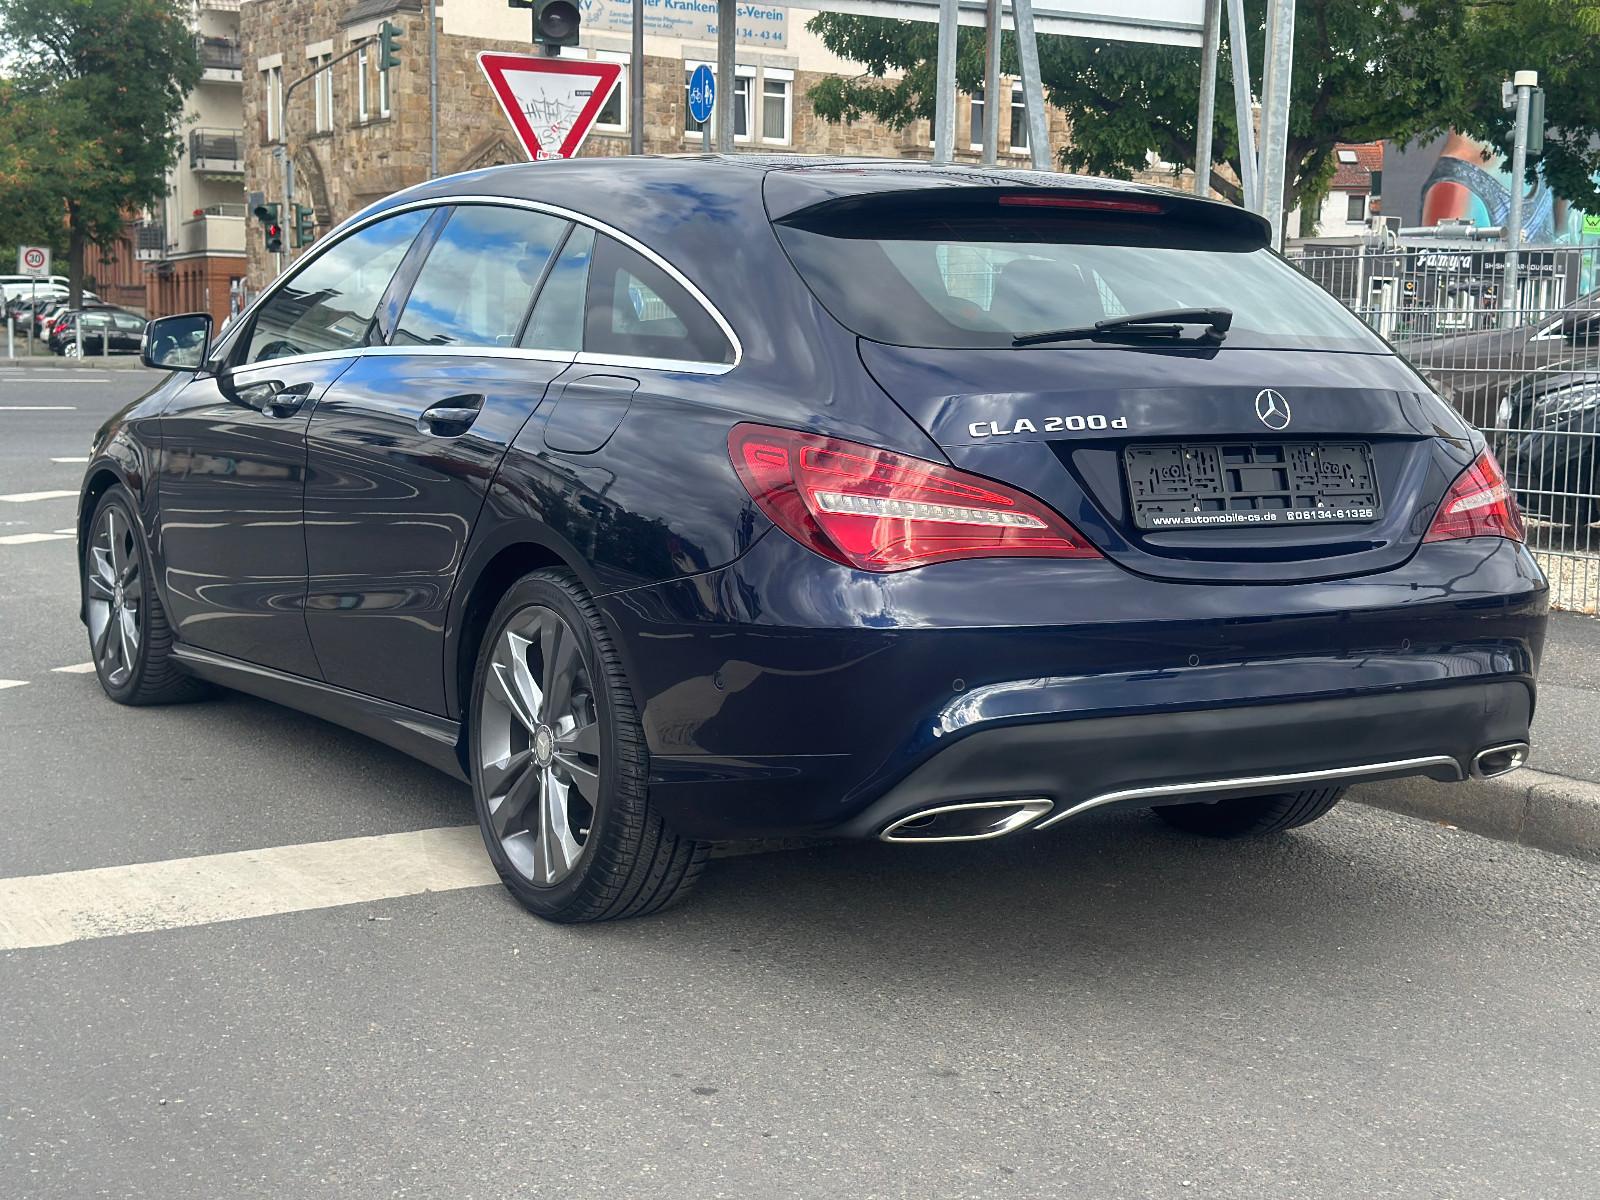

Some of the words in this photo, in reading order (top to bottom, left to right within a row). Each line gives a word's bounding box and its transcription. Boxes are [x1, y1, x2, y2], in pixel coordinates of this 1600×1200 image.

[29, 254, 41, 264] 30
[968, 418, 1038, 438] CLA
[1152, 511, 1277, 525] www.automobile-cs.de
